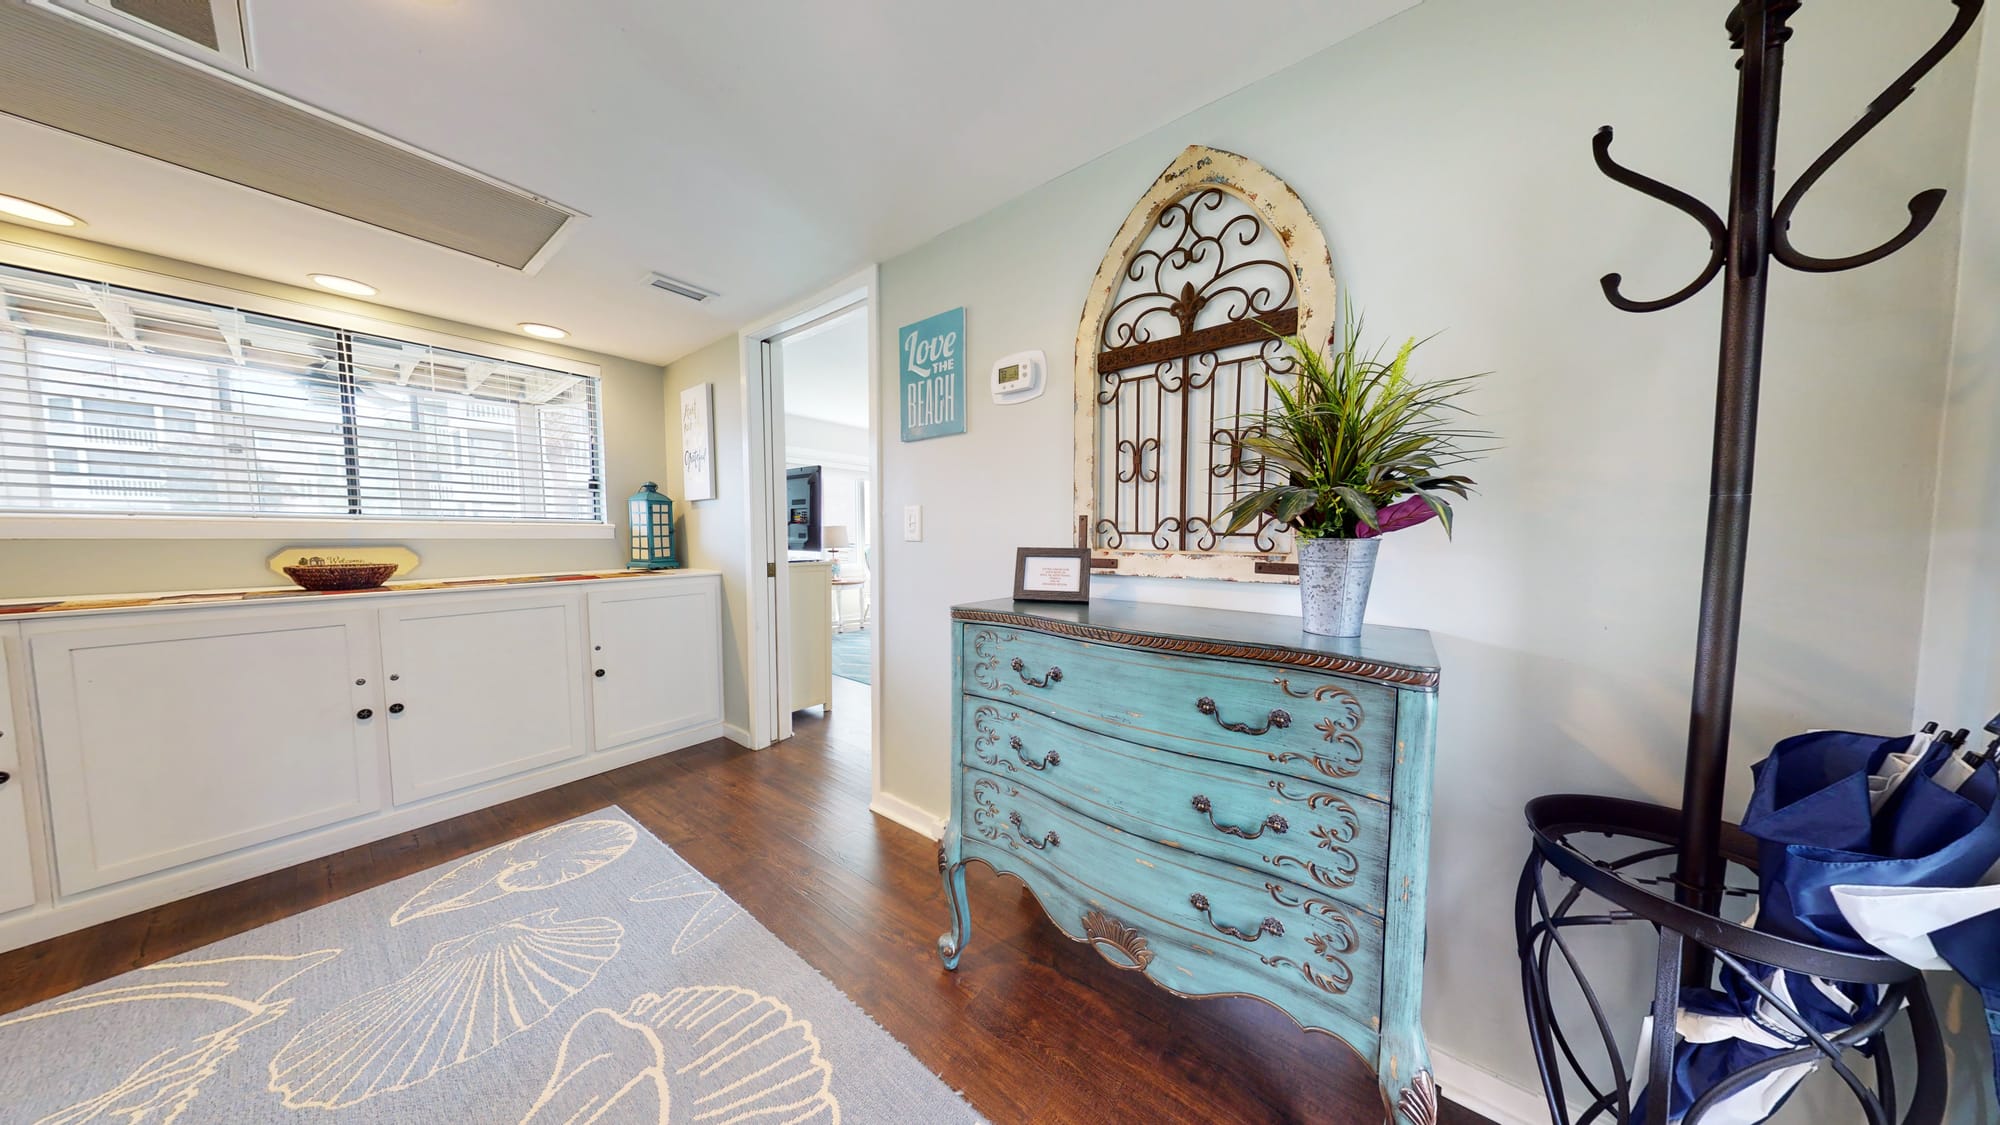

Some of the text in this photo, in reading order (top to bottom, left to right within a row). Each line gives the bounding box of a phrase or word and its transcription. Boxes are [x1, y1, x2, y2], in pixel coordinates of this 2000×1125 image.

[905, 330, 956, 377] Love
[932, 359, 954, 373] THE
[908, 374, 954, 428] BEACH
